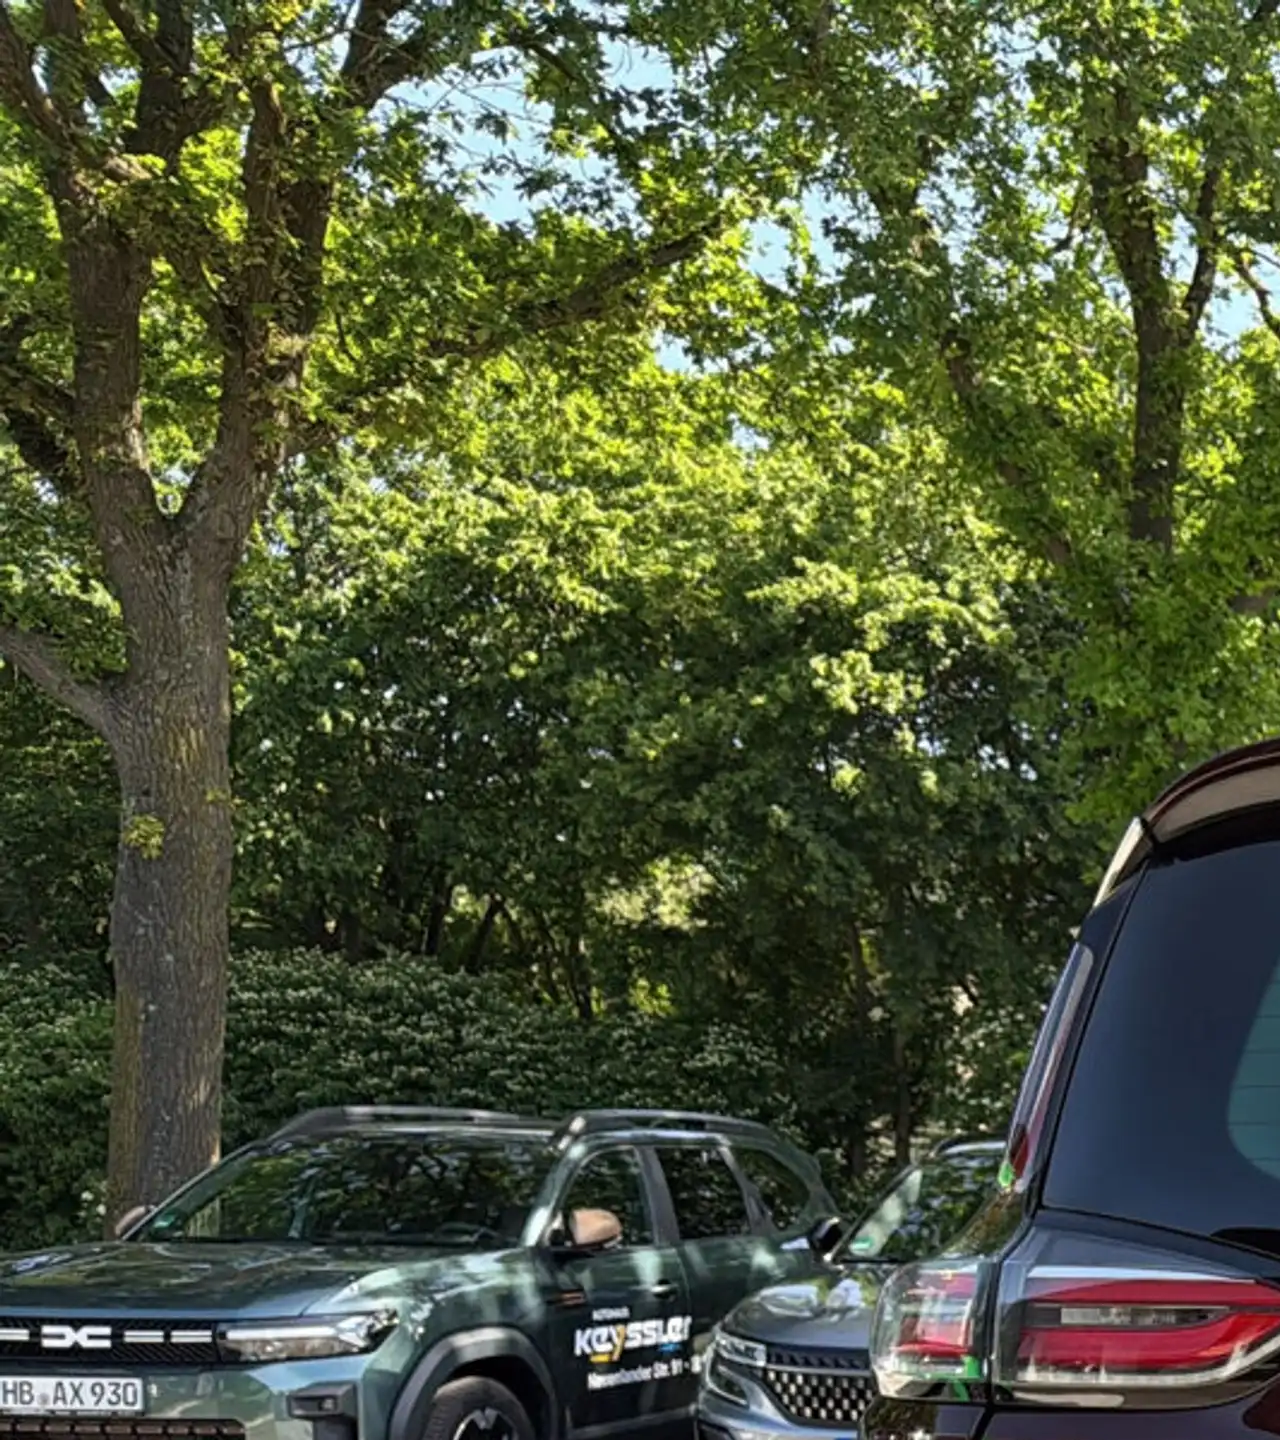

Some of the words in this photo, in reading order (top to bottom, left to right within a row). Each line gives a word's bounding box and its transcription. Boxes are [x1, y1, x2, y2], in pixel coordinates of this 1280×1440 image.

[1, 1380, 34, 1406] HB
[53, 1381, 85, 1406] AX
[91, 1381, 138, 1407] 930
